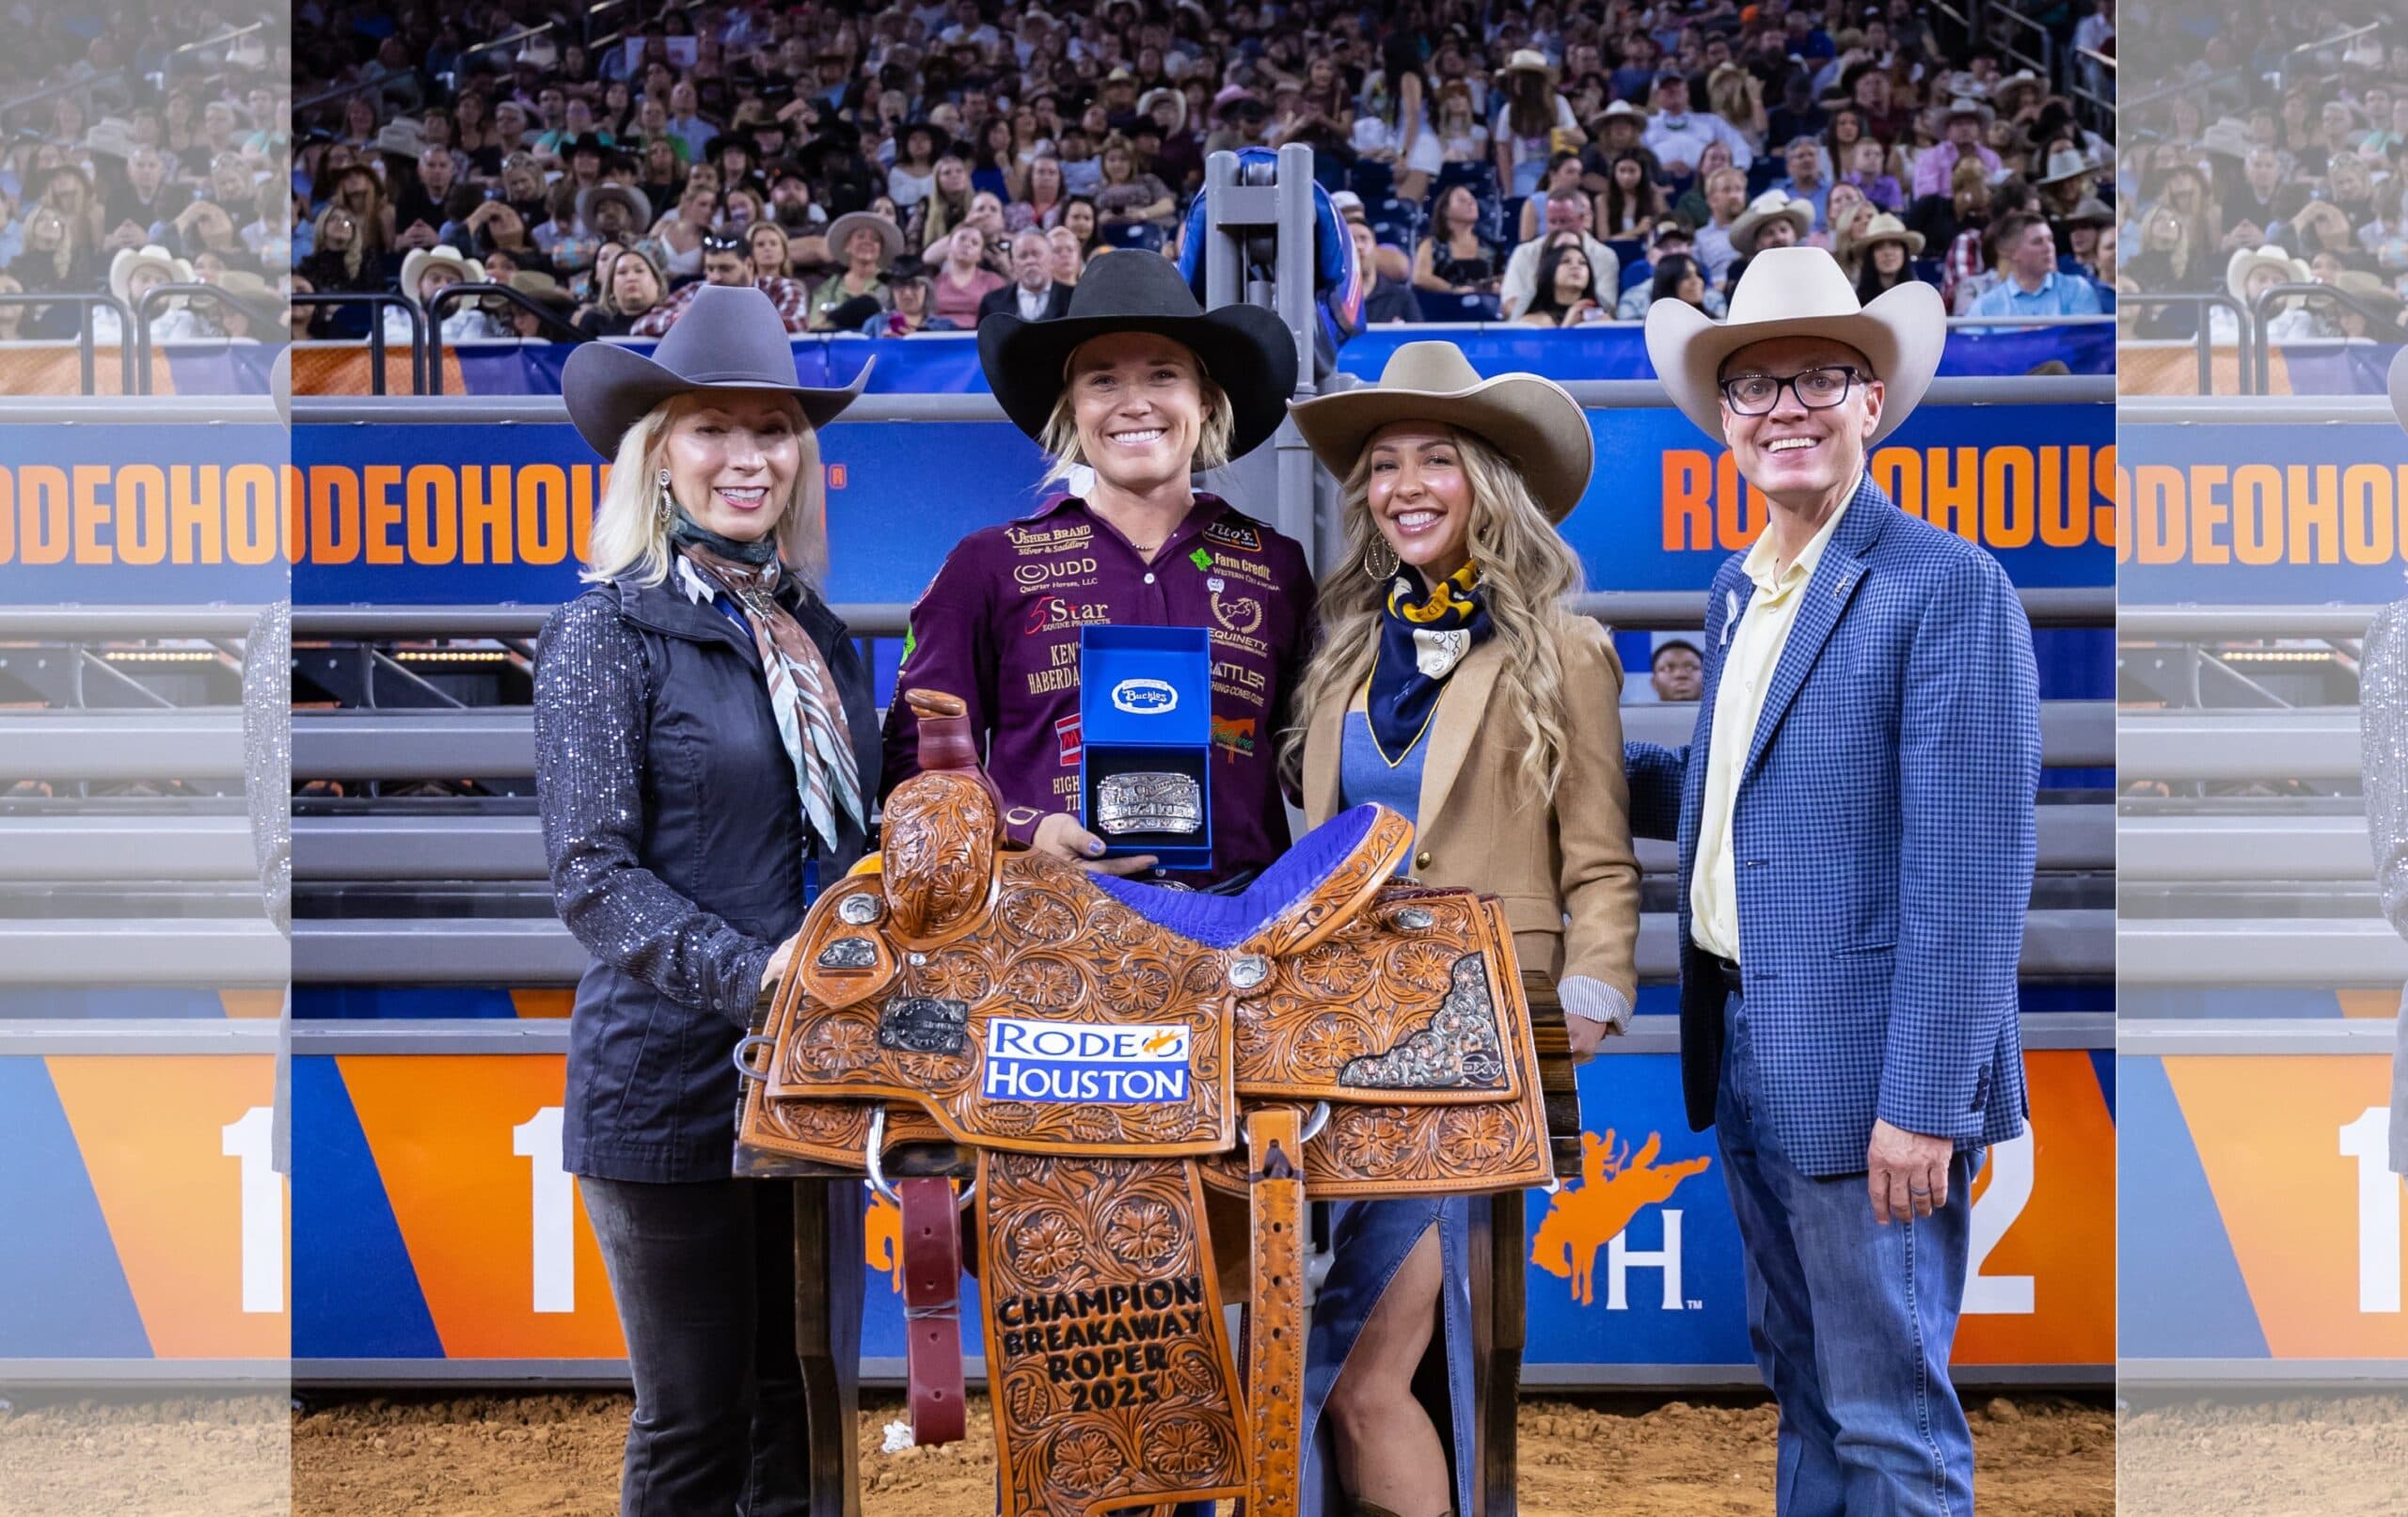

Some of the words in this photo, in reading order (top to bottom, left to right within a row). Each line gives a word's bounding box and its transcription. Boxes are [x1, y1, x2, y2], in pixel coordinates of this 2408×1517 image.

[0, 464, 291, 565] DEOHO
[291, 464, 613, 565] DEOHOU
[1054, 525, 1091, 539] BRAND
[2117, 464, 2408, 565] DEOHO
[1054, 541, 1089, 552] Saddlery
[1214, 552, 1240, 569] Farm
[1242, 559, 1271, 580] Credit
[1024, 596, 1055, 635] 5
[1051, 599, 1108, 623] Star
[1042, 622, 1070, 631] EQUINE
[1051, 641, 1082, 666] KEN'
[1027, 666, 1081, 695] HABERDA
[995, 1023, 1183, 1058] RODEO
[987, 1061, 1184, 1099] HOUSTON
[514, 1107, 575, 1313] 1
[999, 1276, 1201, 1326] CHAMPION
[1005, 1309, 1202, 1356] BREAKAWAY
[1047, 1343, 1170, 1383] ROPER
[1069, 1375, 1160, 1413] 2025
